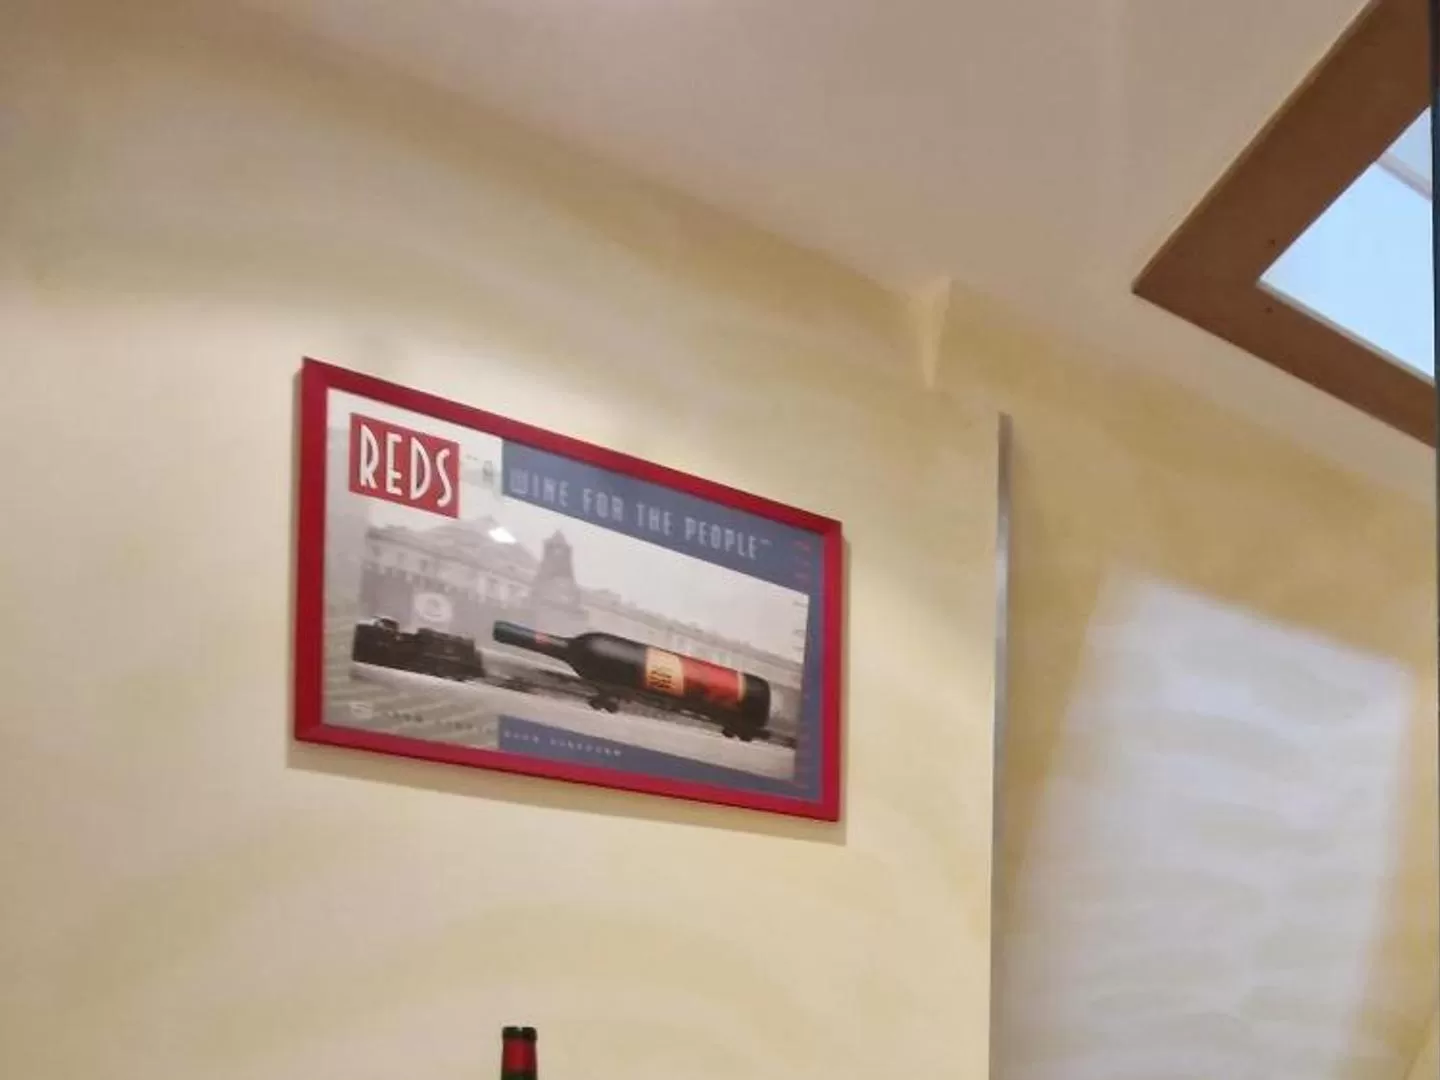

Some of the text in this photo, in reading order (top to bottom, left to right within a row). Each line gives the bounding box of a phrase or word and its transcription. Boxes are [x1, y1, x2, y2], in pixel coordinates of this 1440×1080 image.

[360, 423, 453, 508] REDS
[509, 468, 569, 508] WINE
[583, 487, 624, 523] FOR
[636, 502, 673, 537] THE
